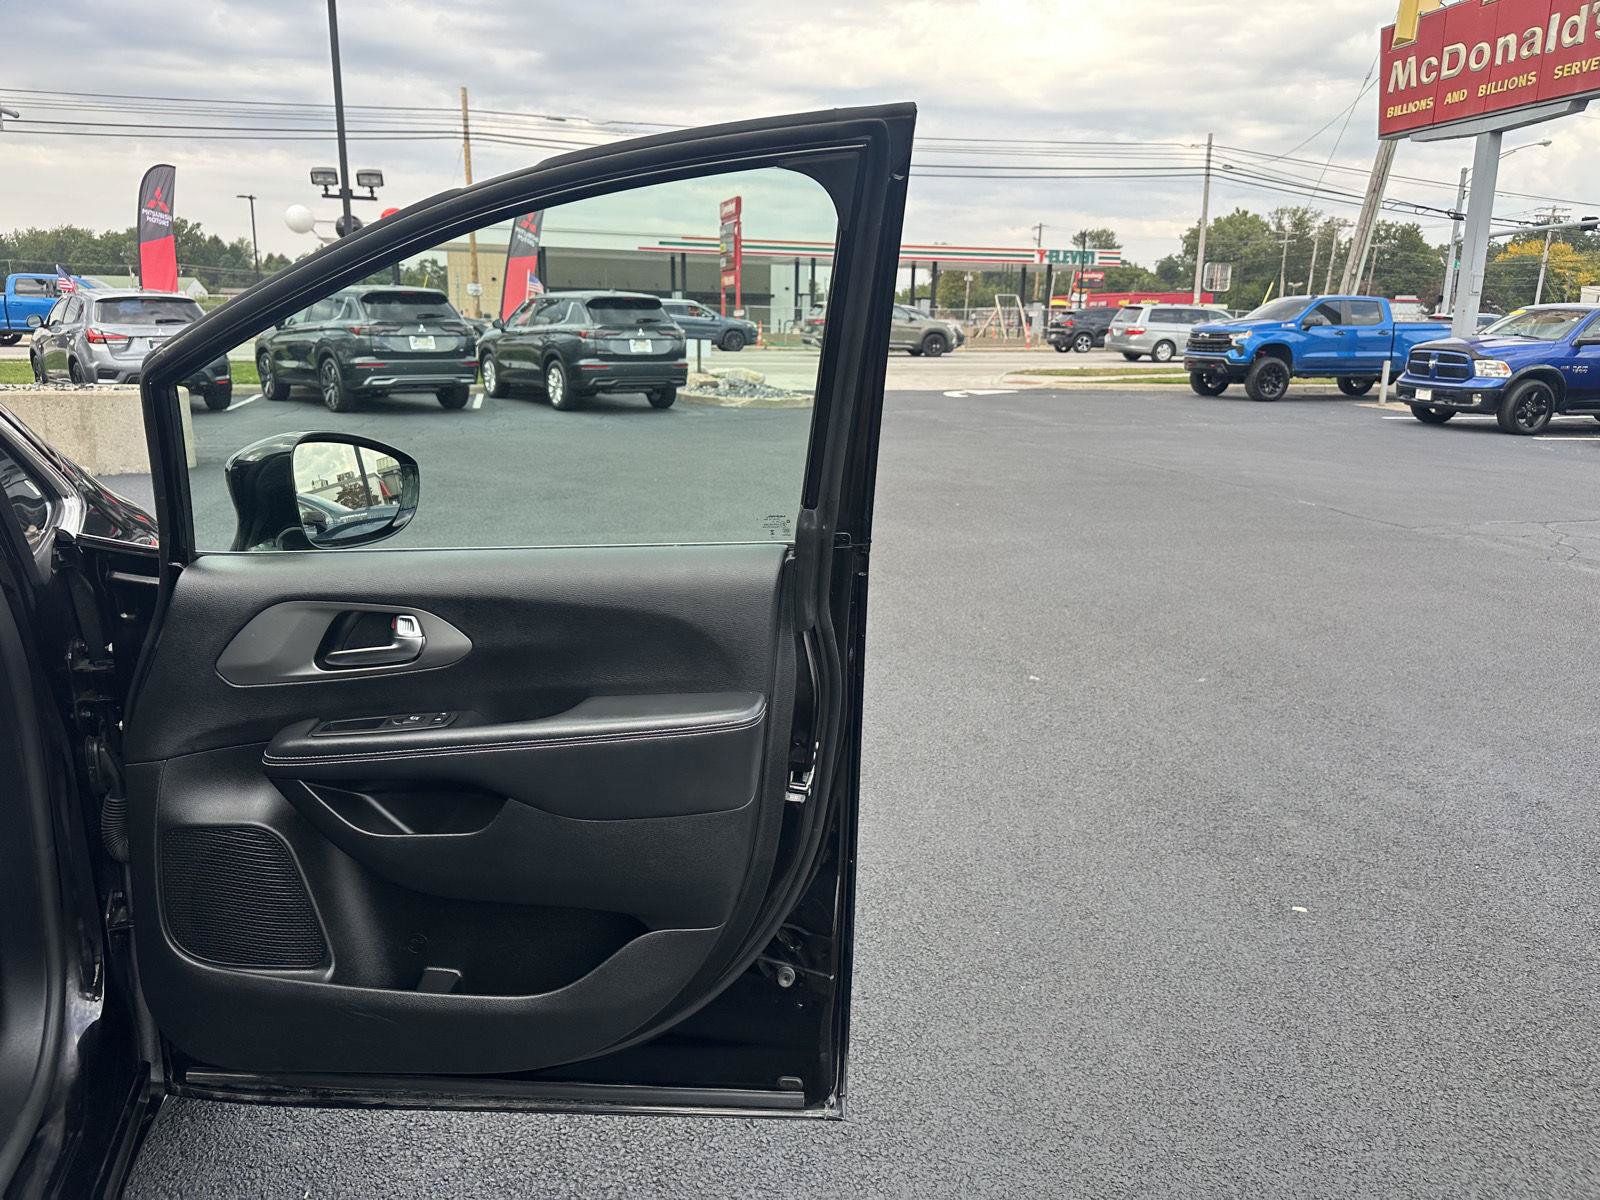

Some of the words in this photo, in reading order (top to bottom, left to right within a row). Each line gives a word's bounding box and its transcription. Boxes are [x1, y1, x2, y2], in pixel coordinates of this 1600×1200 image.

[1386, 97, 1434, 119] BILLIONS
[1443, 88, 1468, 105] AND
[1477, 71, 1537, 97] BILLIONS
[1553, 56, 1600, 80] SERVE
